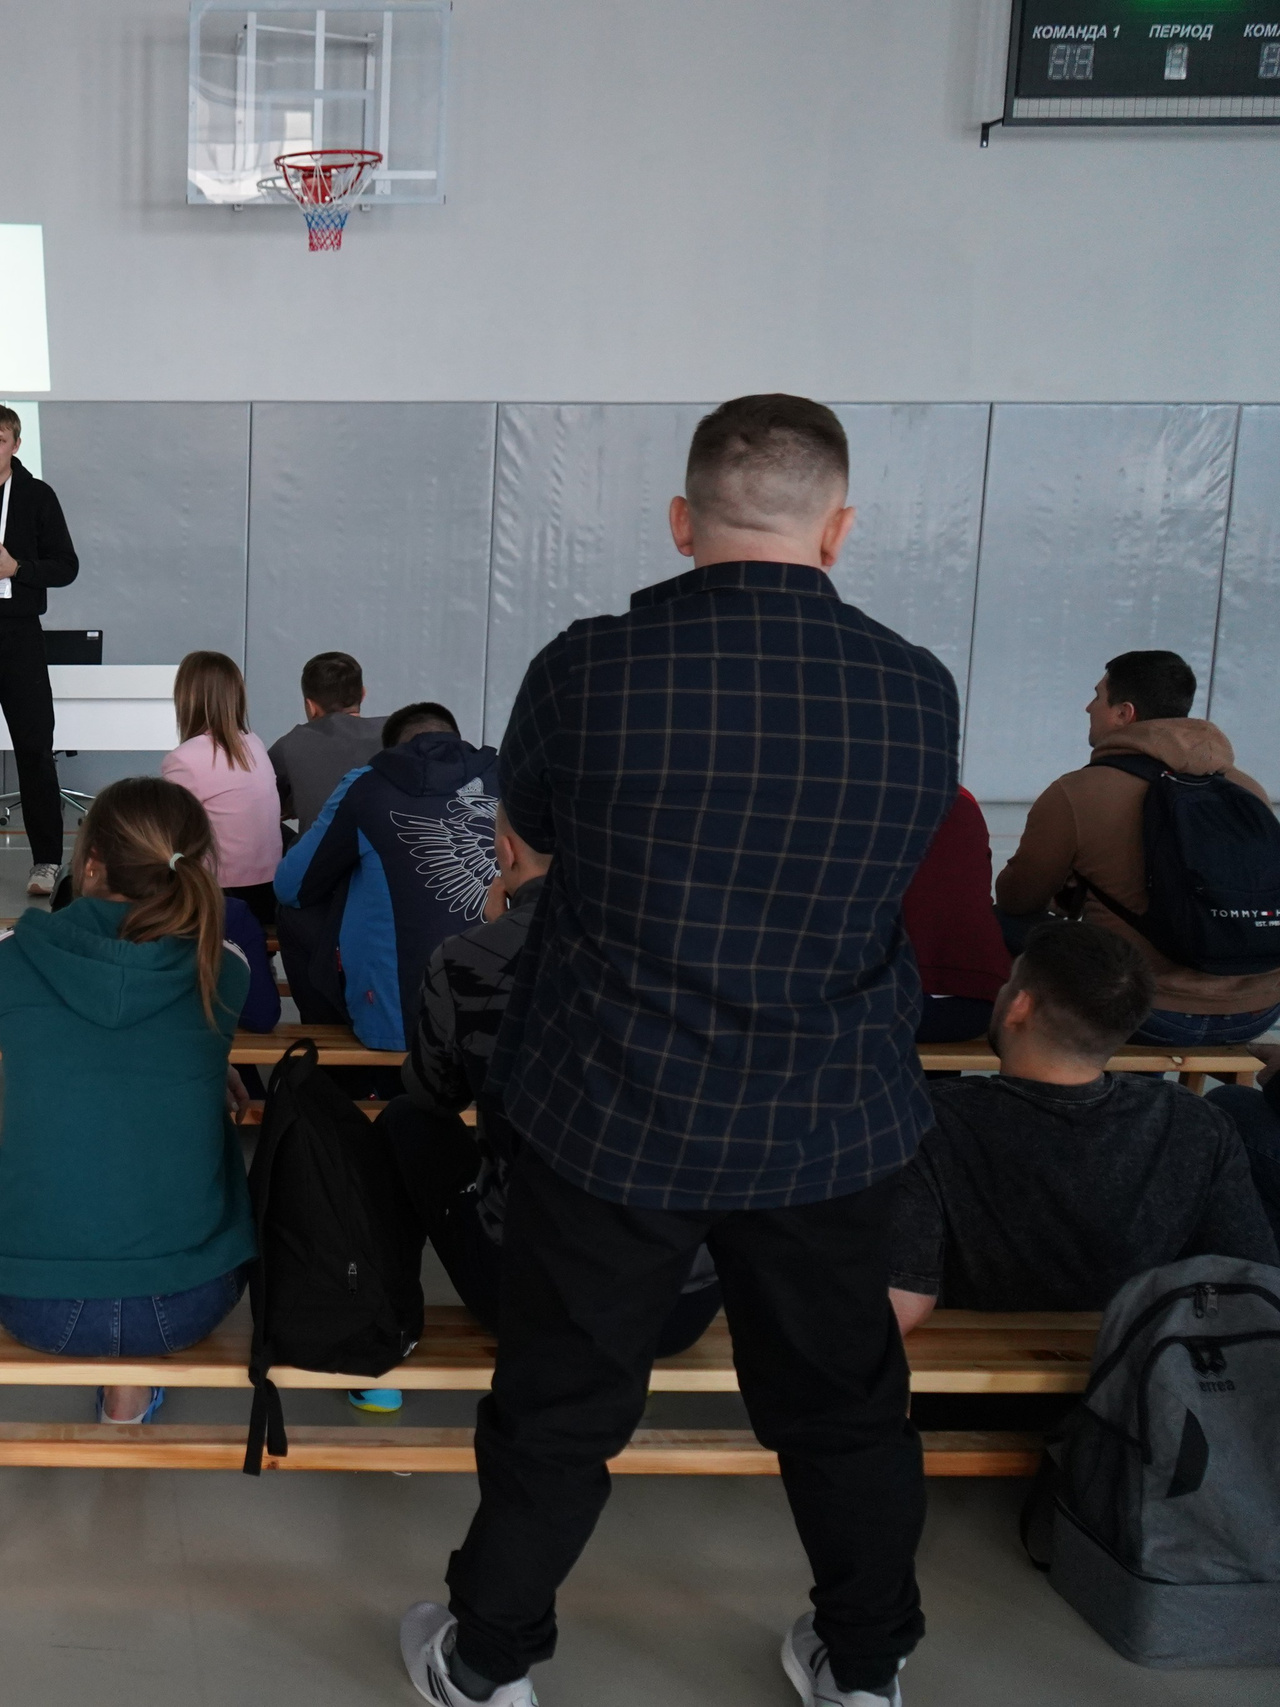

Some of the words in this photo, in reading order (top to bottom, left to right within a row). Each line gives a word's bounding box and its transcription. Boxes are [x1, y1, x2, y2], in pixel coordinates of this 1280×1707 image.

[1032, 25, 1107, 41] КОМАНДА
[1113, 25, 1121, 38] 1
[1149, 24, 1214, 41] ПЕРИОД
[1210, 909, 1259, 918] TOMMY
